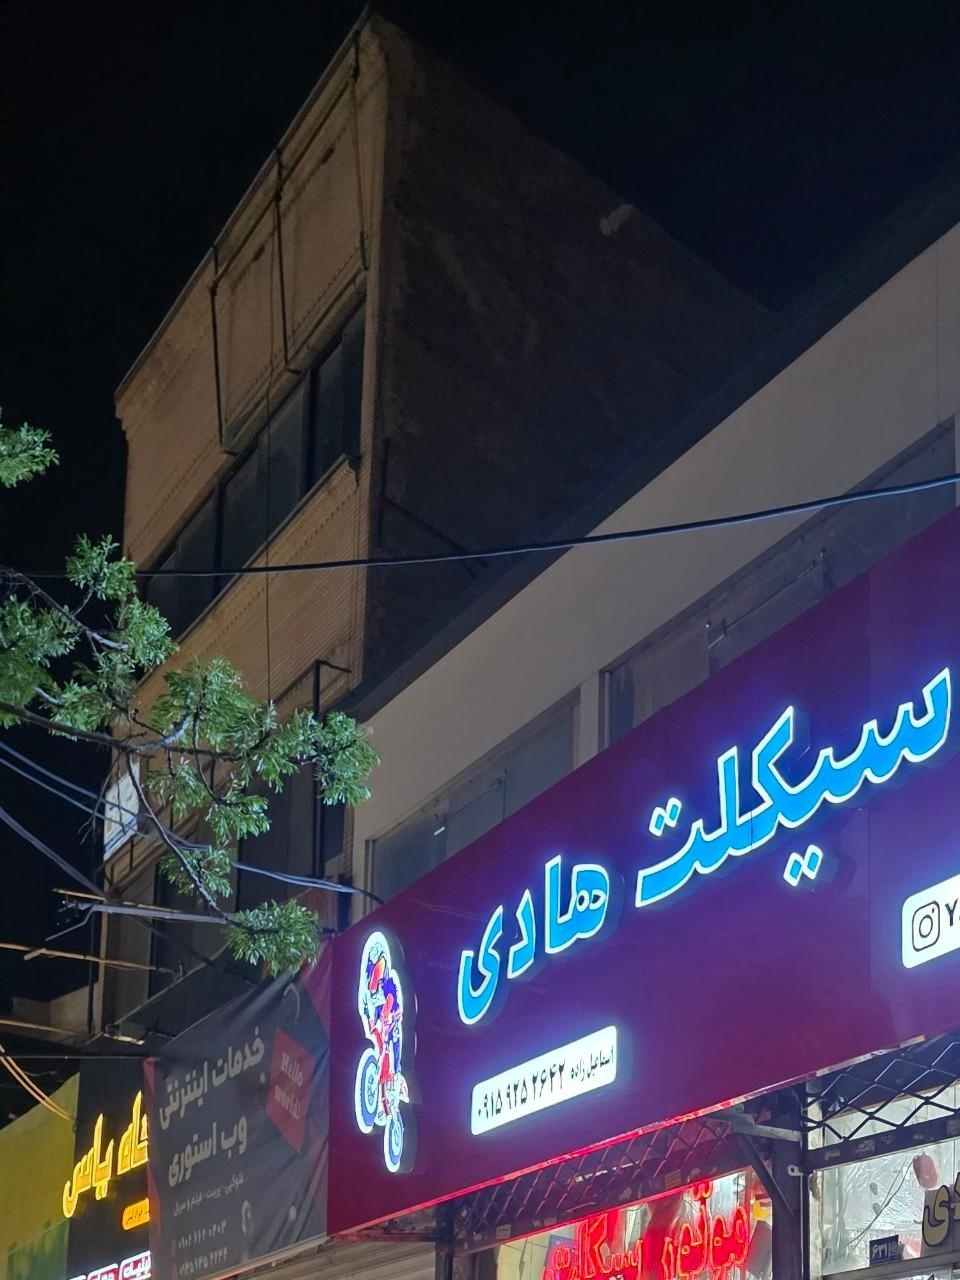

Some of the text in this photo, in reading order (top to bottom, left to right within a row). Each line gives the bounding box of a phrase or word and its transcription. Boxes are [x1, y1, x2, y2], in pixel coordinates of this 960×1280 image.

[634, 667, 952, 908] سیکلت
[457, 855, 608, 1025] هادی
[159, 1026, 265, 1130] خدمات اینترنتی
[280, 1051, 304, 1088] Hello
[168, 1114, 248, 1188] وب استوری
